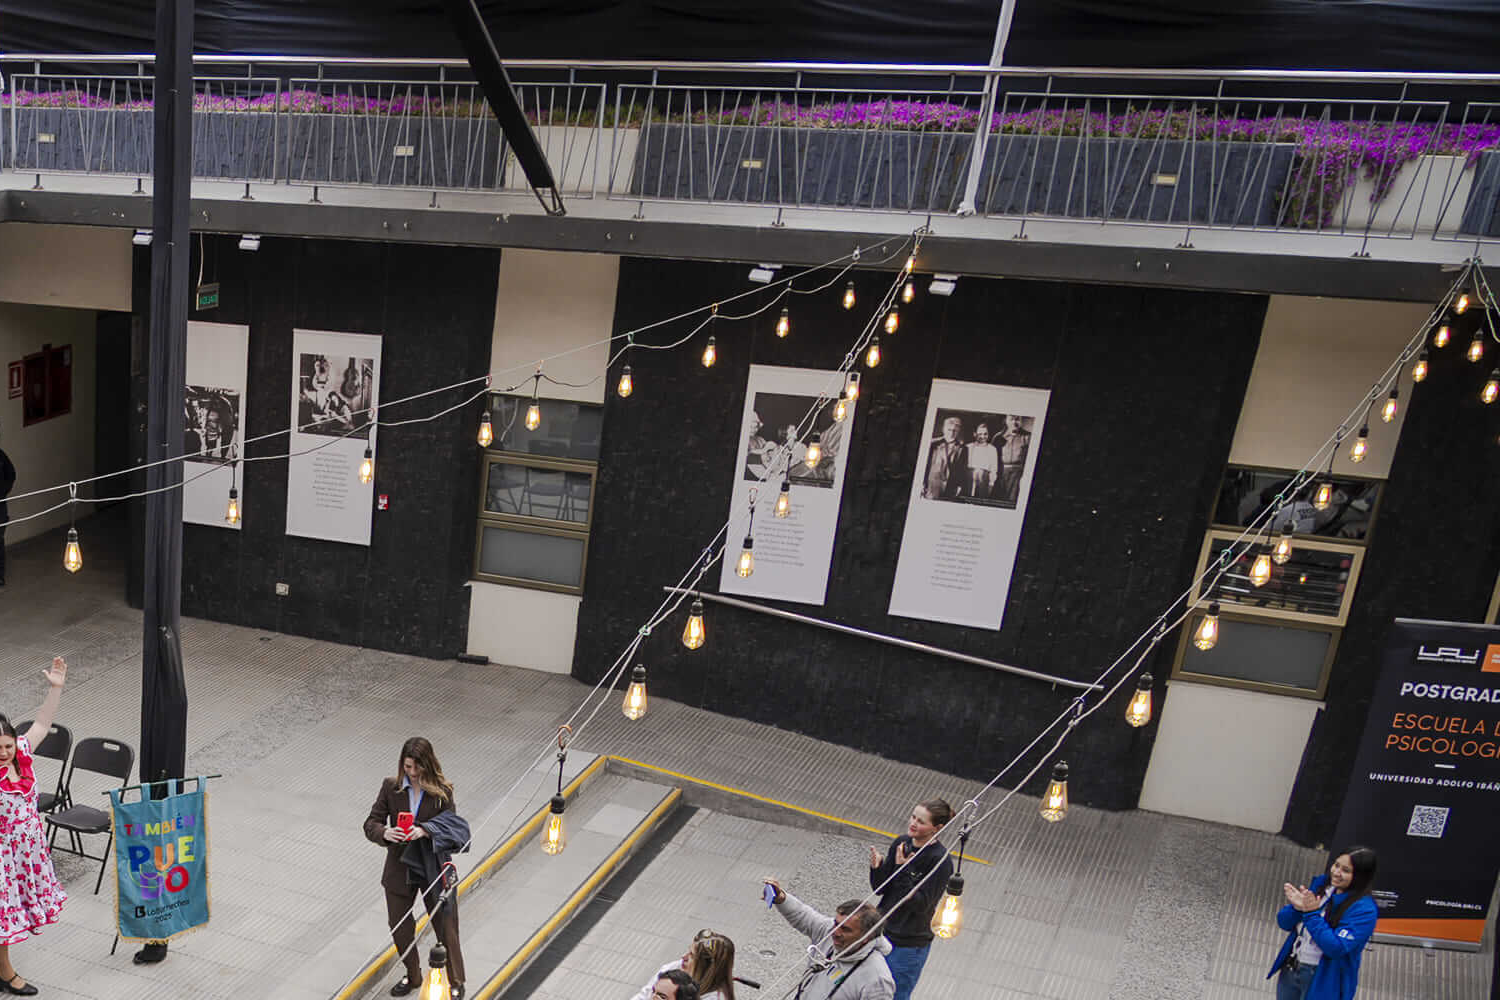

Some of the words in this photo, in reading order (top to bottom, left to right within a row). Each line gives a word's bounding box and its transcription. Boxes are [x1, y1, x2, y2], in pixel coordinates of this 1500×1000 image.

[1392, 712, 1485, 735] ESCUELA
[1369, 772, 1434, 785] UNIVERSIDAD
[1436, 778, 1474, 789] ADOLFO
[124, 812, 195, 836] TAMBIÉN
[128, 835, 196, 873] PUE
[140, 865, 189, 900] DO
